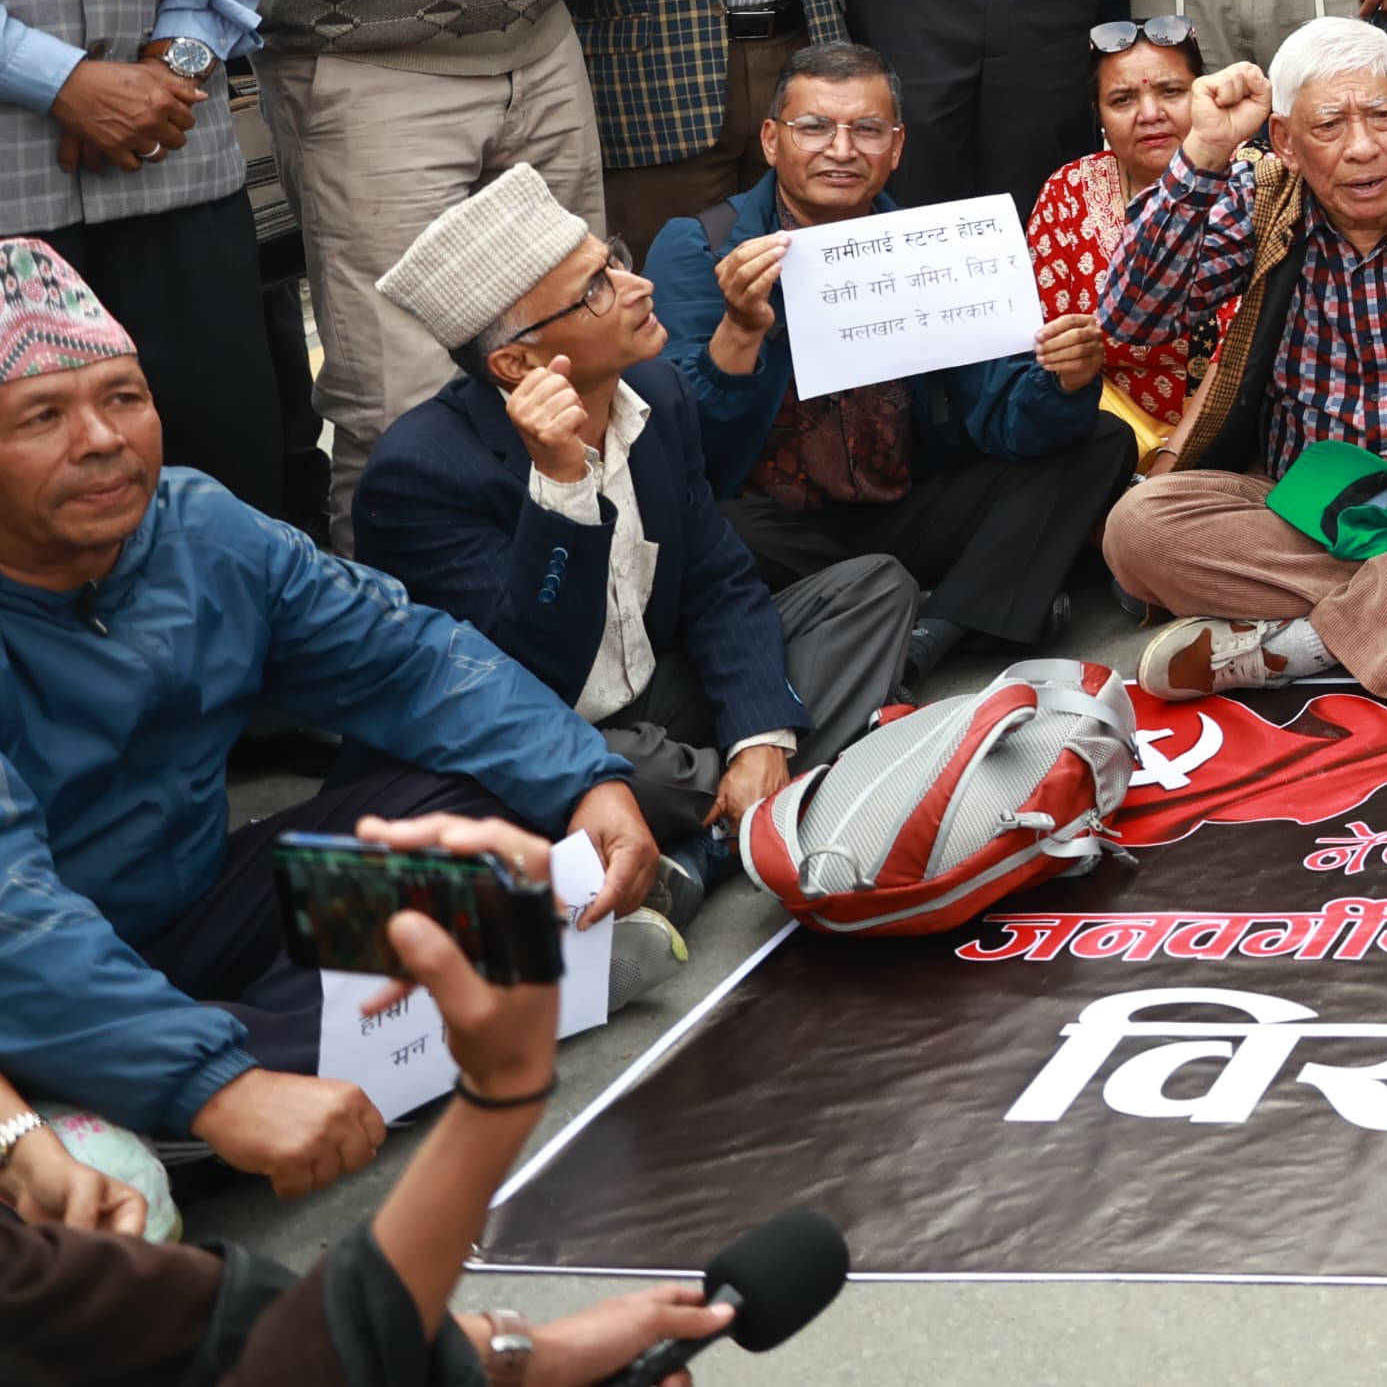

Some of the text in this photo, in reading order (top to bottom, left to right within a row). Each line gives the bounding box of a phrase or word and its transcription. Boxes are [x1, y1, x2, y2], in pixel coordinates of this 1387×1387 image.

[820, 229, 894, 265] हामीलाई
[902, 226, 949, 249] स्टन्ट
[820, 282, 859, 306] खेती
[1007, 254, 1019, 269] र
[837, 300, 997, 343] मलखाद दे सरकार
